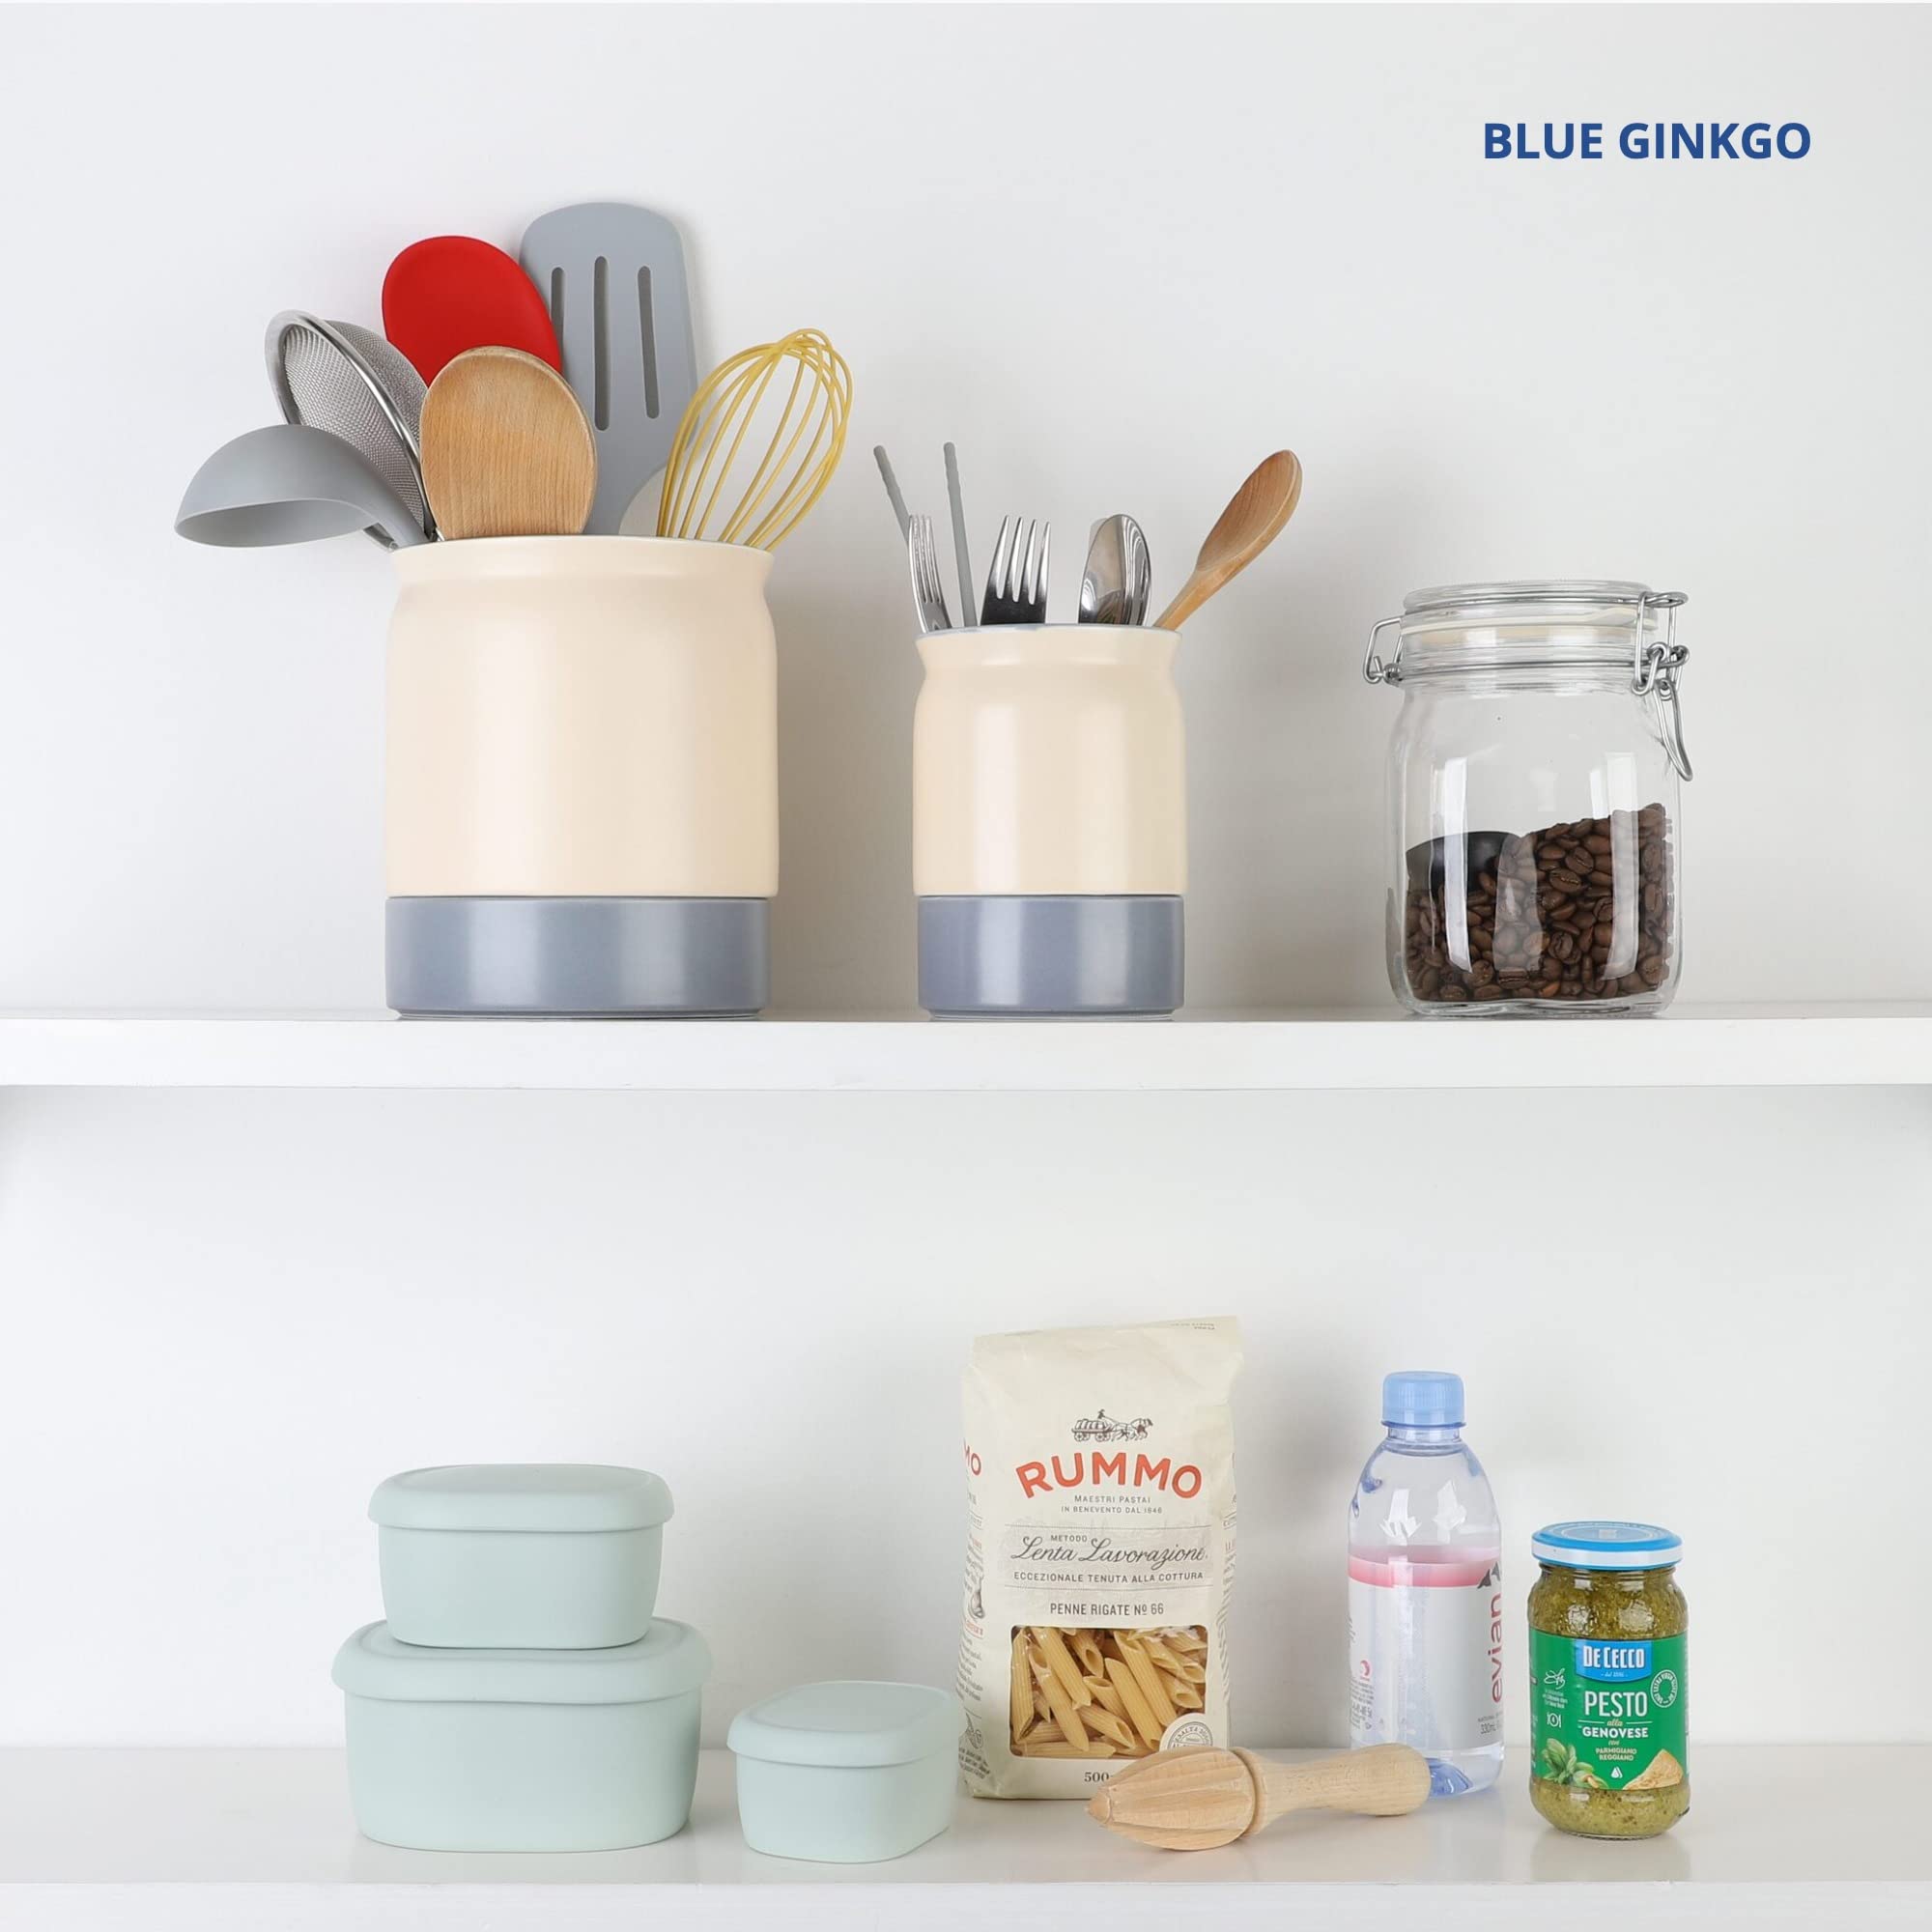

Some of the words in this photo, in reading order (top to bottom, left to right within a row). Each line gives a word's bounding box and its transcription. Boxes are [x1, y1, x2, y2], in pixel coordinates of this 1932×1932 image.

[1015, 1451, 1203, 1499] RUMMO
[1074, 1494, 1116, 1503] MAESTRI
[1119, 1495, 1151, 1504] PASTAI
[1050, 1534, 1088, 1543] METODO
[1010, 1535, 1078, 1562] Lenta
[1014, 1572, 1084, 1583] ECCEZIONALE
[1088, 1574, 1128, 1584] TENUTA
[1131, 1574, 1155, 1583] ALLA
[1158, 1572, 1204, 1582] COTTURA
[1050, 1603, 1087, 1615] PENNE
[1091, 1604, 1130, 1616] RIGATE
[1151, 1604, 1165, 1615] 66
[1488, 1594, 1502, 1703] evian
[1584, 1690, 1648, 1718] PESTO
[1582, 1726, 1649, 1739] GENOVESE
[1595, 1747, 1637, 1755] PARMIGIANO
[1084, 1771, 1113, 1783] 500
